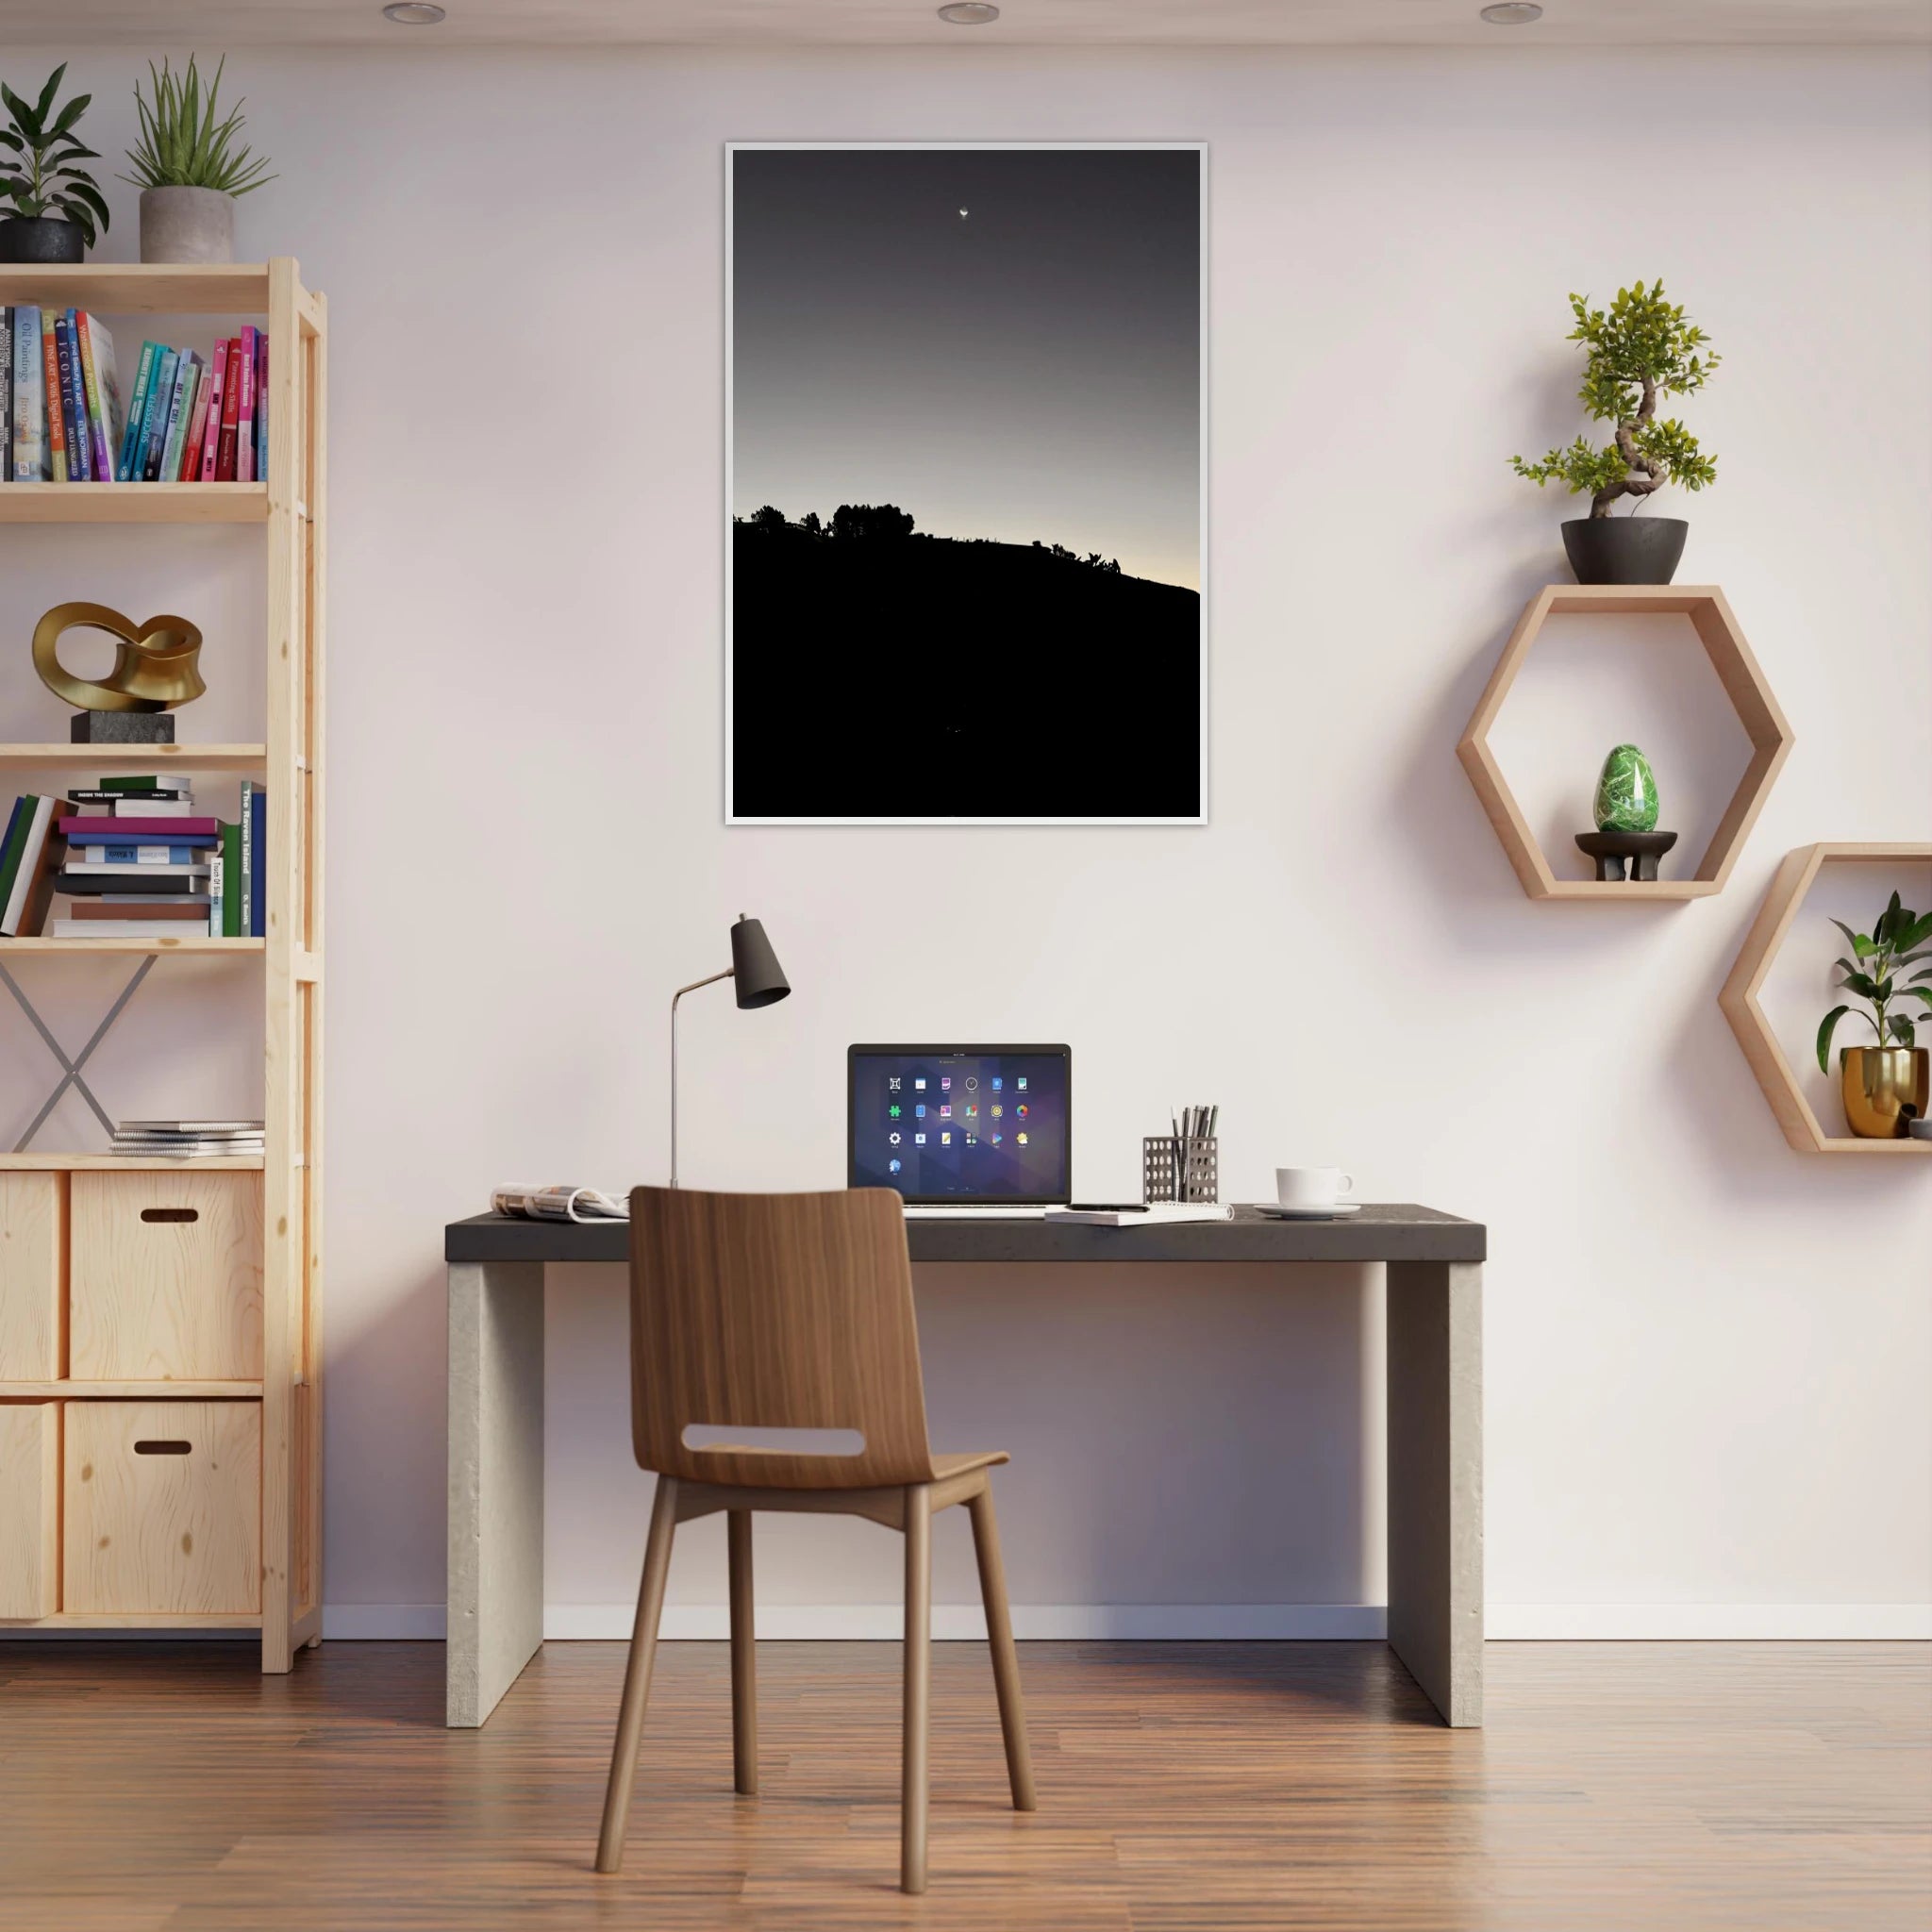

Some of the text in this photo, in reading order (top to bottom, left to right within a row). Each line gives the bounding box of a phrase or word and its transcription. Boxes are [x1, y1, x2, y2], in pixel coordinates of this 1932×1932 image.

[19, 323, 33, 383] Oil Paintings
[48, 363, 57, 375] ART
[79, 325, 92, 370] Watercolor
[87, 373, 97, 408] Portraits
[49, 382, 58, 398] With
[227, 360, 240, 413] Parenting Skills
[53, 422, 61, 440] Tools
[79, 438, 89, 469] NORMAN
[242, 789, 251, 808] The
[242, 810, 251, 841] Raven
[212, 861, 221, 878] Touch
